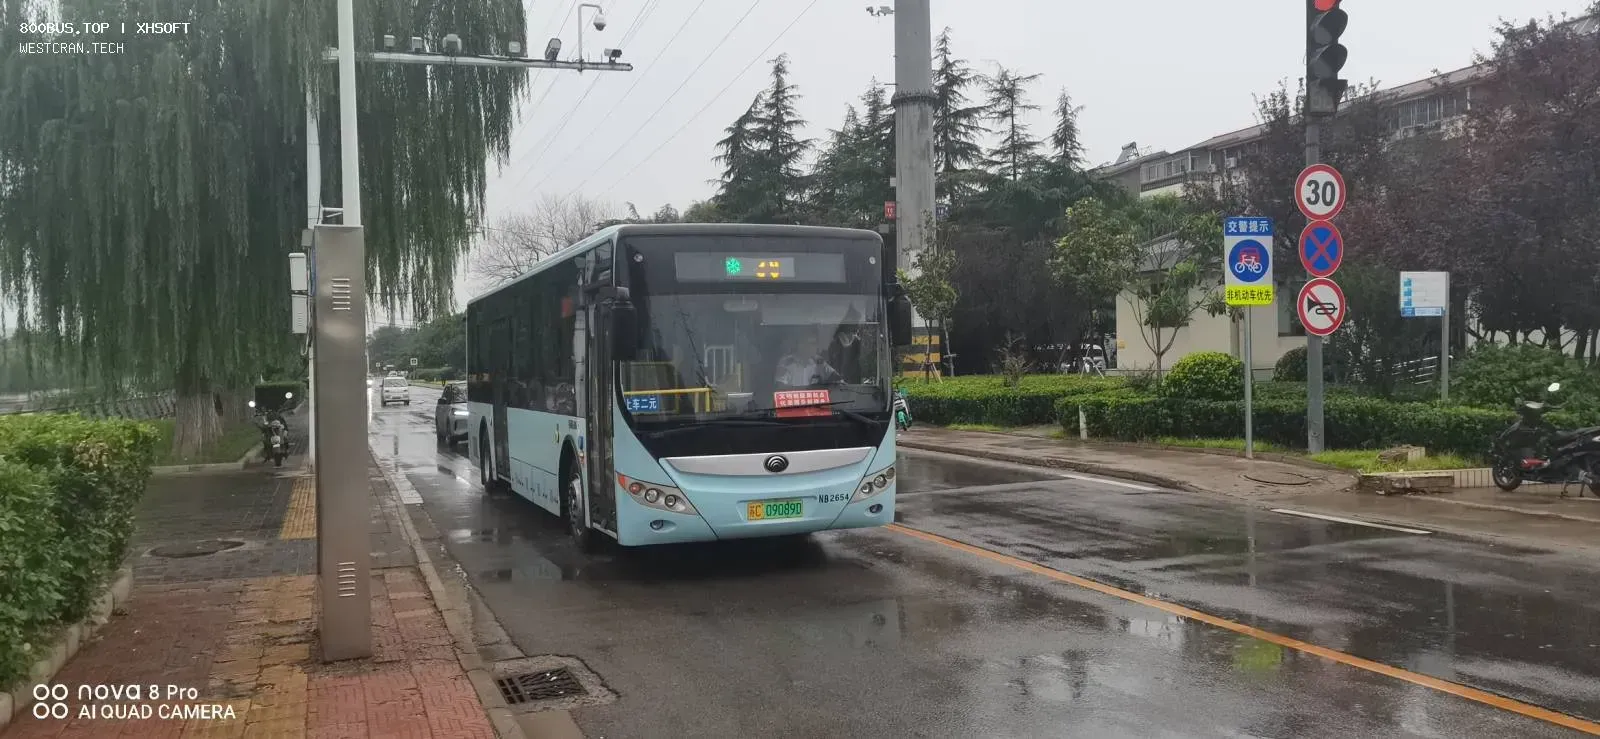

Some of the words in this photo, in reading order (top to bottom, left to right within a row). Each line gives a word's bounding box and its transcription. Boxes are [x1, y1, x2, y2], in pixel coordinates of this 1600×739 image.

[1305, 179, 1336, 207] 30
[1227, 220, 1269, 233] 交警提示
[1226, 289, 1272, 301] 非机动车优先
